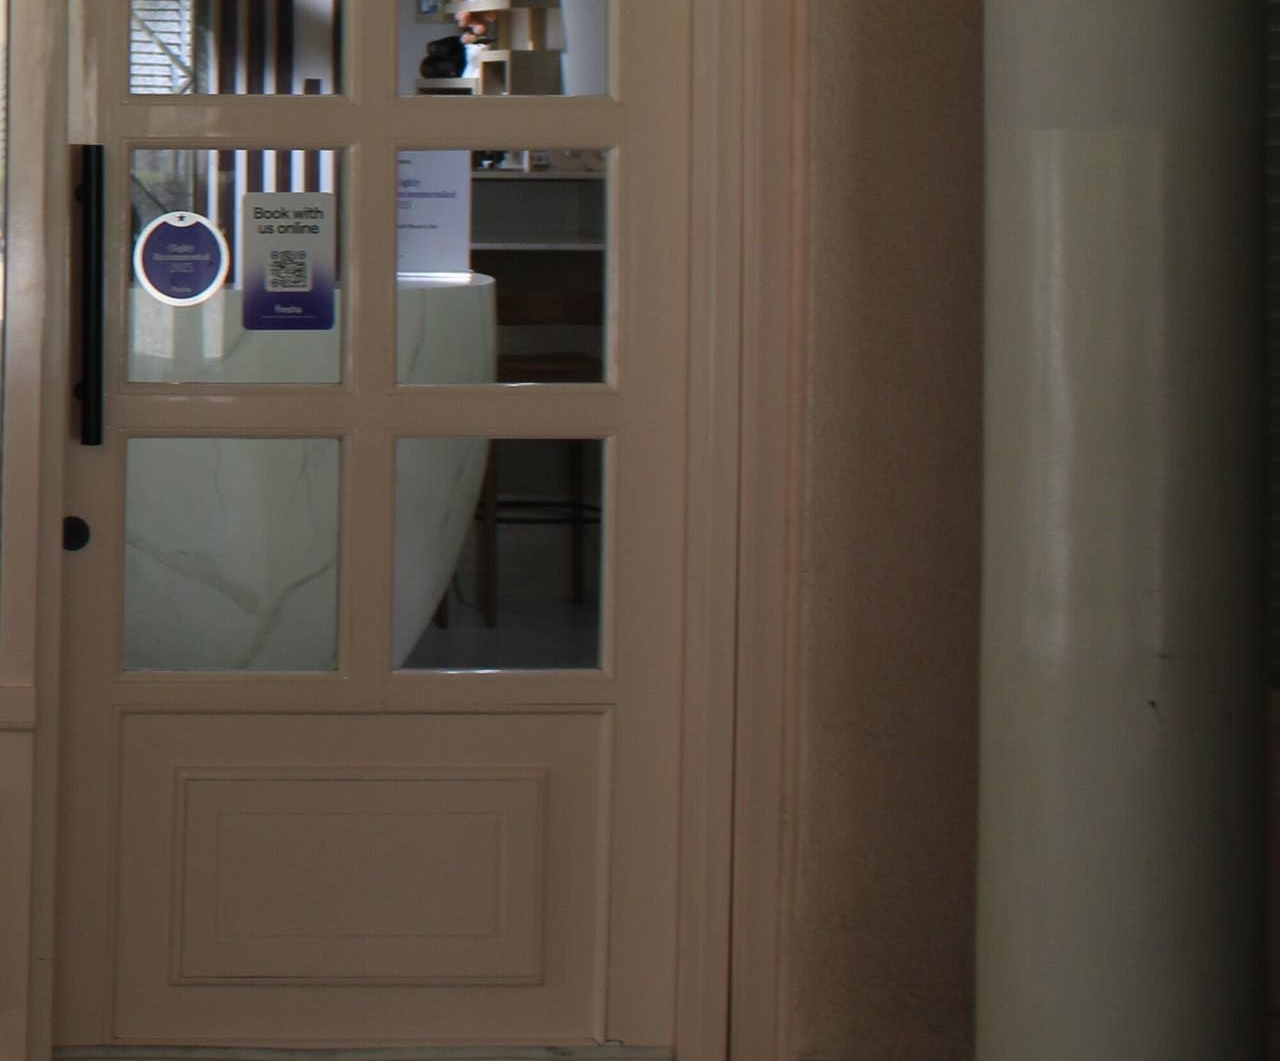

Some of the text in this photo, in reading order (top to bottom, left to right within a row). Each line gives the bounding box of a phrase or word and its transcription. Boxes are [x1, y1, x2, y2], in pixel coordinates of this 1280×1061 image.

[253, 206, 325, 219] Book with
[258, 222, 320, 234] us online
